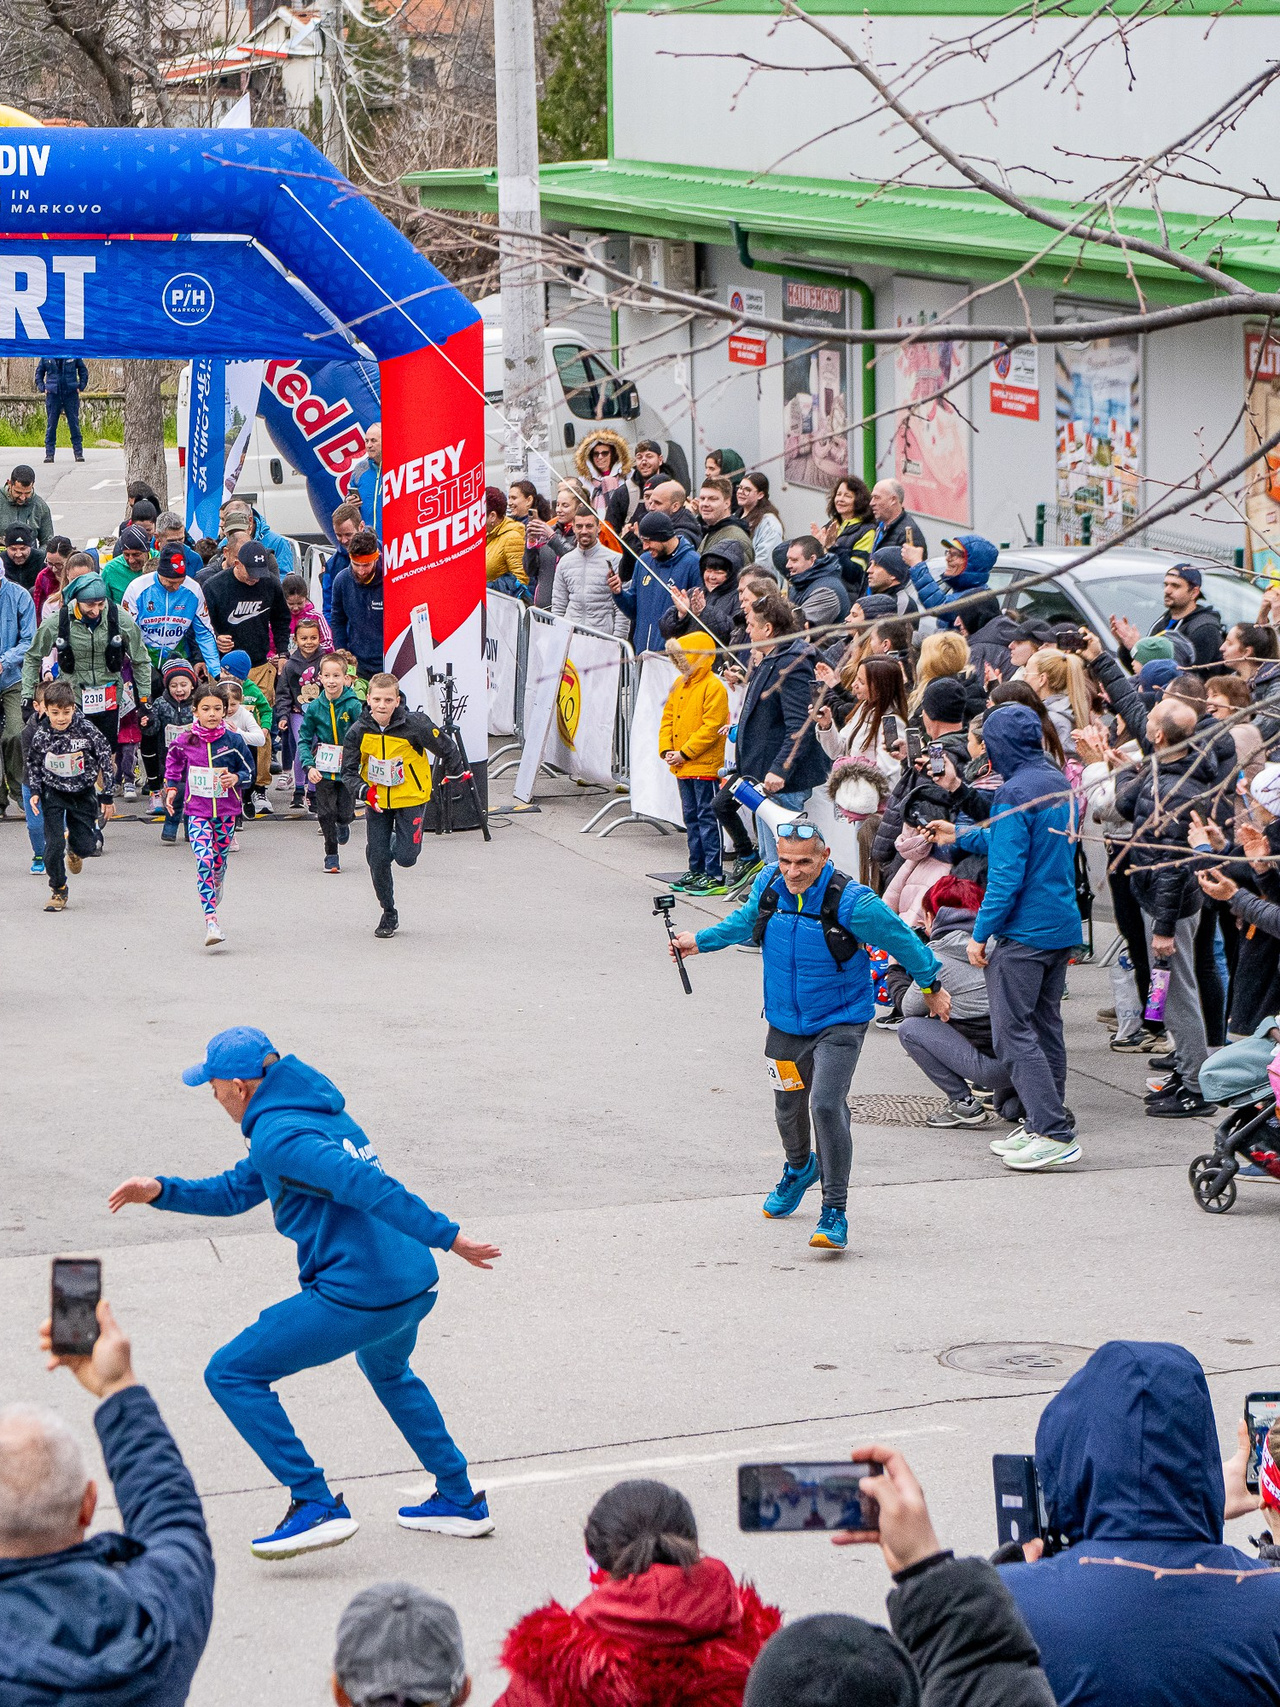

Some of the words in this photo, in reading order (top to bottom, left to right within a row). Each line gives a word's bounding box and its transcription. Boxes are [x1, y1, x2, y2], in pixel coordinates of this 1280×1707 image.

[11, 189, 30, 200] IN
[11, 204, 102, 214] MARKOVO
[172, 289, 206, 307] P/H
[382, 439, 466, 508] EVERY
[417, 461, 484, 525] STEP
[383, 490, 487, 577] MATTERS
[234, 600, 263, 616] NIKE
[84, 693, 103, 704] 2318
[321, 751, 334, 762] 177
[50, 760, 65, 769] 150
[371, 764, 385, 776] 175
[193, 775, 207, 786] 131
